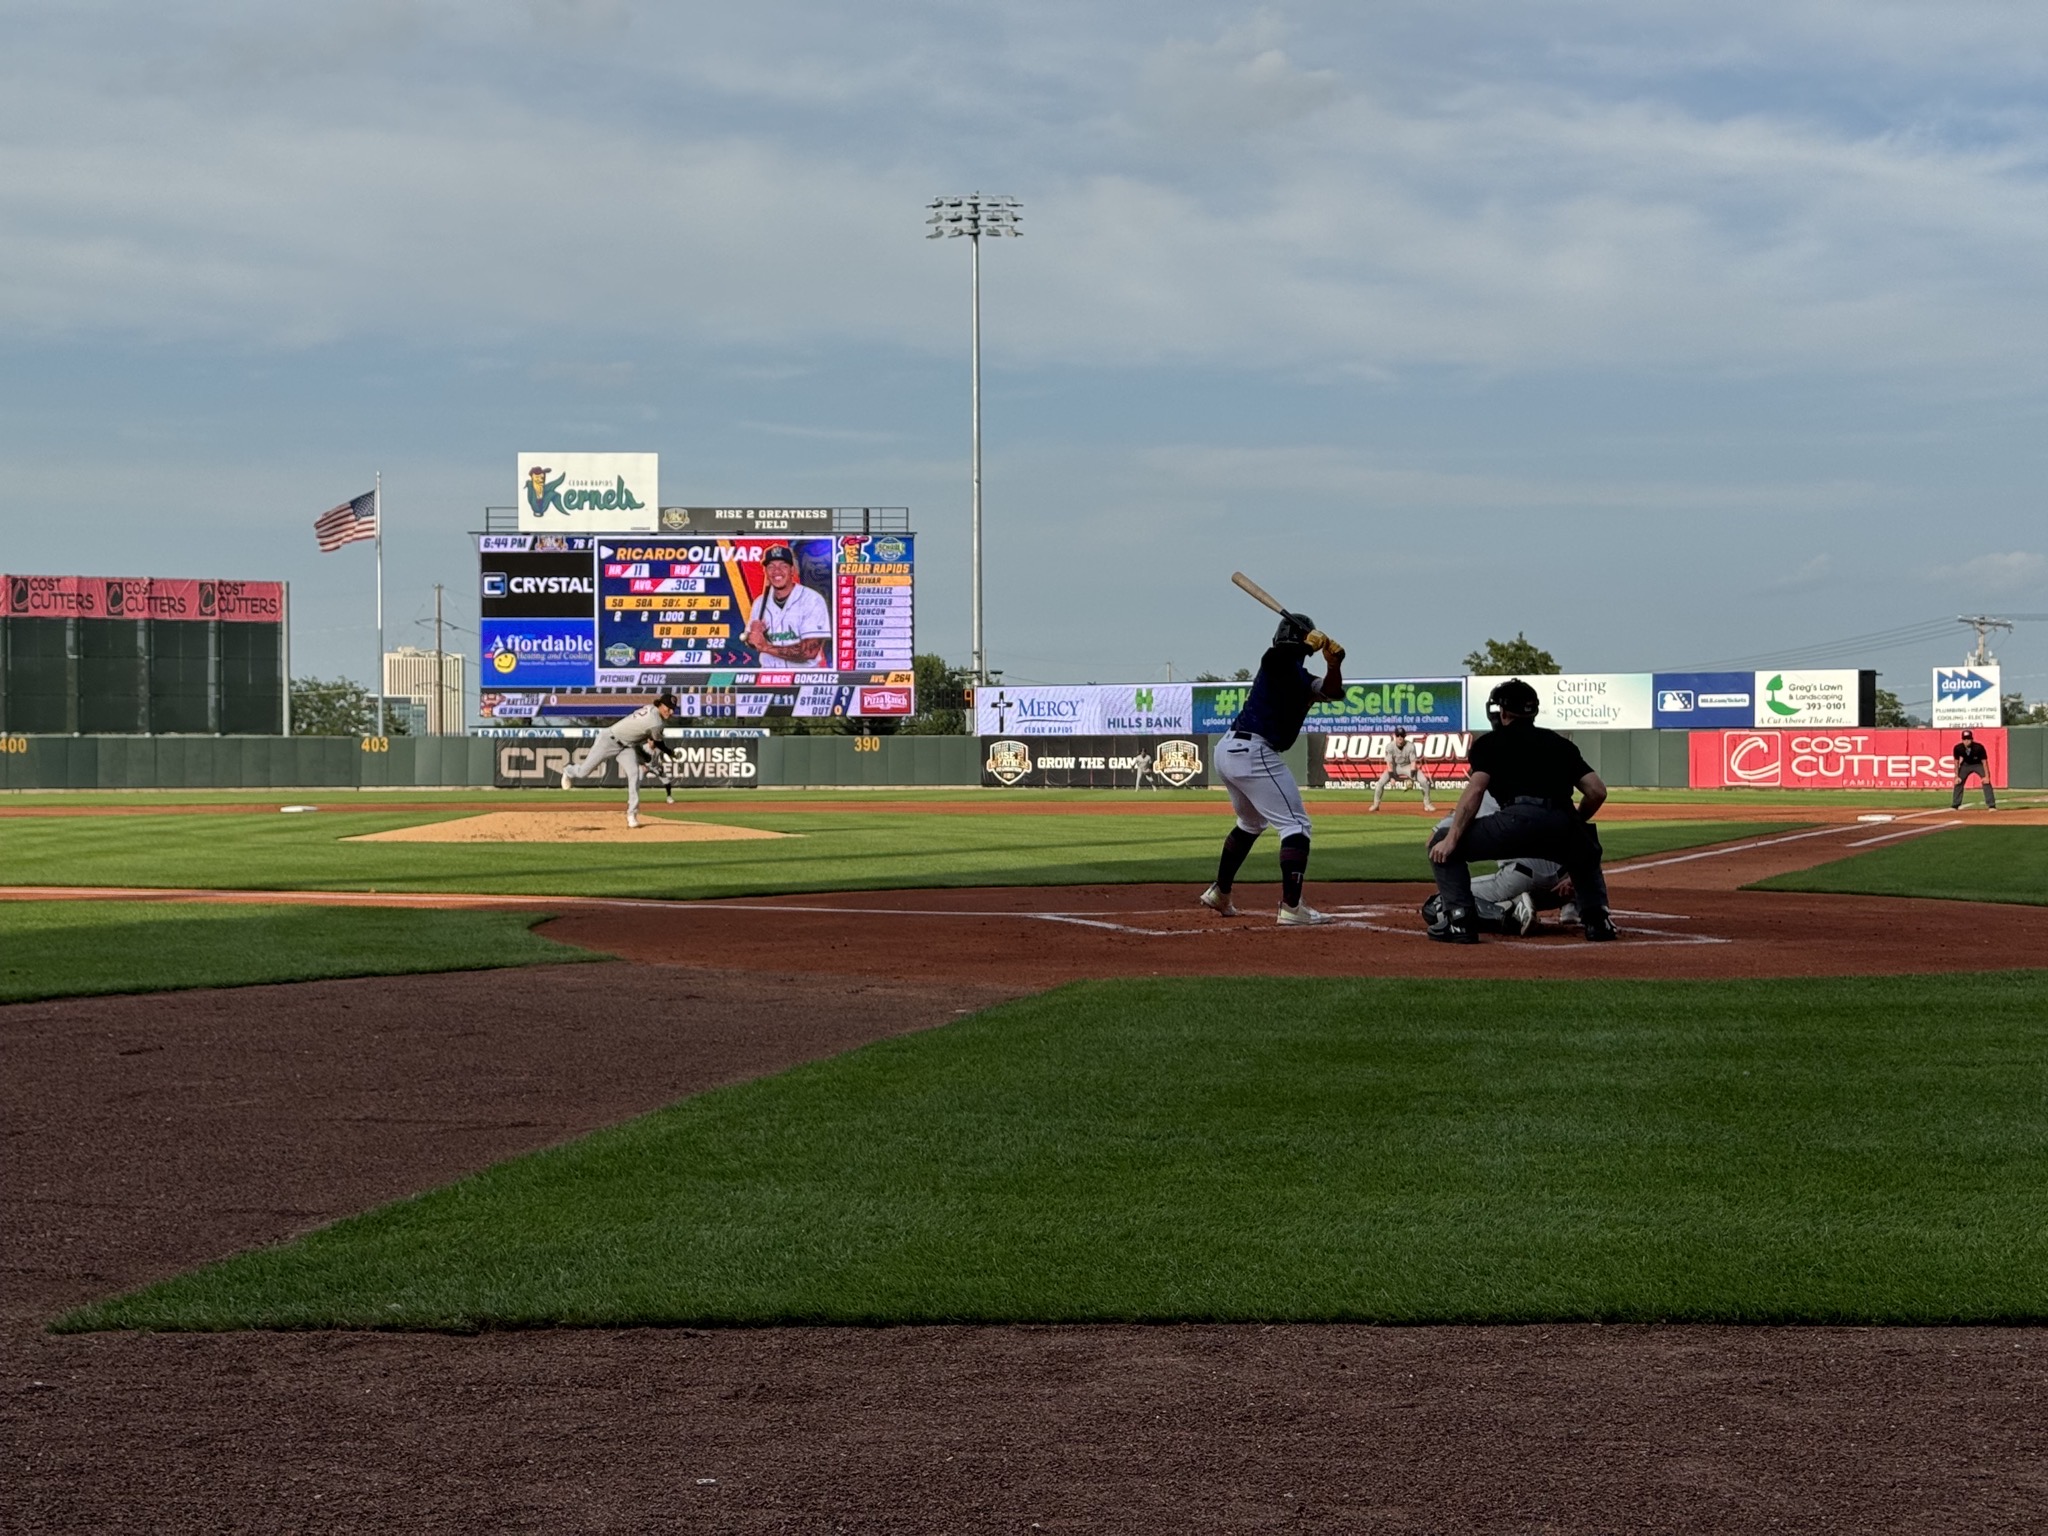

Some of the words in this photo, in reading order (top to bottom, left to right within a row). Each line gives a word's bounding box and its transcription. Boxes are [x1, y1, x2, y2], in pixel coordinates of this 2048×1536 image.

[568, 479, 588, 488] CEDAR
[591, 479, 613, 488] RAPIDS
[524, 467, 645, 516] Kernels
[715, 510, 743, 519] RISE
[746, 510, 754, 519] 2
[758, 510, 828, 519] GREATNESS
[754, 520, 788, 529] FIELD
[483, 538, 509, 549] 6:44
[511, 538, 528, 549] PM
[573, 539, 585, 549] 76
[616, 547, 688, 561] RICARDO
[688, 546, 762, 562] OLIVAR
[608, 564, 623, 575] HR
[634, 564, 643, 576] 11
[674, 564, 691, 575] RBI
[699, 565, 715, 576] 44
[839, 563, 871, 575] CEDAR
[873, 563, 910, 575] RAPIDS
[31, 578, 61, 592] COST
[509, 577, 594, 595] CRYSTAL
[633, 579, 654, 591] AVG.
[671, 579, 697, 591] .302
[856, 577, 882, 585] OLIVAR
[125, 582, 151, 596] COST
[217, 582, 246, 596] COST
[856, 586, 893, 595] GONZALEZ
[30, 593, 95, 611] CUTTERS
[125, 596, 187, 614] CUTTERS
[217, 596, 278, 615] CUTTERS
[612, 598, 624, 608] SB
[635, 598, 653, 608] SBA
[687, 598, 699, 608] SF
[709, 598, 722, 608] SH
[856, 598, 893, 606] CESPEDES
[614, 611, 621, 622] 2
[641, 611, 649, 622] 2
[659, 611, 685, 622] 1.000
[689, 611, 697, 622] 2
[712, 610, 720, 621] 0
[856, 608, 886, 616] DONCON
[857, 618, 884, 627] MAITAN
[660, 626, 672, 636] BB
[708, 626, 721, 636] PA
[857, 628, 881, 637] HARRY
[490, 634, 594, 653] Affordable
[661, 638, 672, 649] 51
[687, 638, 695, 649] 0
[706, 638, 725, 649] 322
[563, 651, 594, 662] Cooling
[643, 651, 663, 662] OPS
[680, 651, 703, 663] .917
[857, 661, 876, 669] HESS
[599, 674, 635, 684] PITCHING
[641, 674, 667, 685] CRUZ
[735, 674, 756, 684] MPH
[760, 675, 771, 684] ON
[772, 675, 790, 684] DECK
[794, 673, 839, 684] GONZALEZ
[890, 673, 911, 683] .264
[1557, 677, 1607, 694] Caring
[1788, 683, 1817, 693] Greg's
[1819, 682, 1843, 692] Lawn
[1941, 678, 1982, 690] dalton
[812, 686, 834, 695] BALL
[841, 686, 849, 696] 0
[687, 695, 695, 705] 0
[705, 695, 712, 704] 0
[724, 695, 731, 704] 0
[741, 695, 752, 703] AT
[754, 695, 768, 703] BAT
[799, 696, 832, 705] STRIKE
[840, 696, 846, 706] 1
[863, 693, 884, 706] Pizza
[885, 693, 908, 706] Ranch
[964, 689, 973, 708] 9
[1553, 690, 1565, 705] is
[1567, 694, 1593, 705] our
[1795, 693, 1843, 702] Landscaping
[498, 707, 533, 715] KERNELS
[687, 706, 695, 715] 0
[705, 706, 712, 715] 0
[724, 706, 731, 716] 0
[747, 706, 762, 715] H/E
[811, 706, 830, 715] OUT
[1018, 698, 1080, 718] MERCY
[1556, 704, 1621, 721] specialty
[1107, 717, 1142, 729] HILLS
[1146, 717, 1182, 728] BANK
[1202, 717, 1226, 727] upload
[1334, 716, 1350, 724] with
[1403, 715, 1415, 724] for
[1415, 716, 1421, 724] a
[1421, 715, 1449, 724] chance
[1758, 717, 1765, 725] A
[1767, 716, 1781, 725] Cut
[1782, 716, 1807, 725] Above
[1808, 716, 1823, 725] The
[1024, 726, 1045, 734] CEDAR
[1047, 726, 1073, 734] RAPIDS
[1307, 724, 1319, 733] the
[1319, 724, 1332, 734] big
[360, 737, 389, 753] 403
[854, 736, 880, 752] 390
[1325, 734, 1470, 760] ROBSON
[1791, 736, 1869, 754] COST
[1037, 757, 1075, 769] GROW
[1078, 756, 1105, 769] THE
[1108, 756, 1138, 769] GAM
[1791, 754, 1956, 778] CUTTERS
[662, 762, 756, 778] ELIVERED
[1324, 780, 1365, 789] BUILDINGS
[1842, 779, 1883, 787] FAMILY
[1924, 779, 1954, 788] SALO
